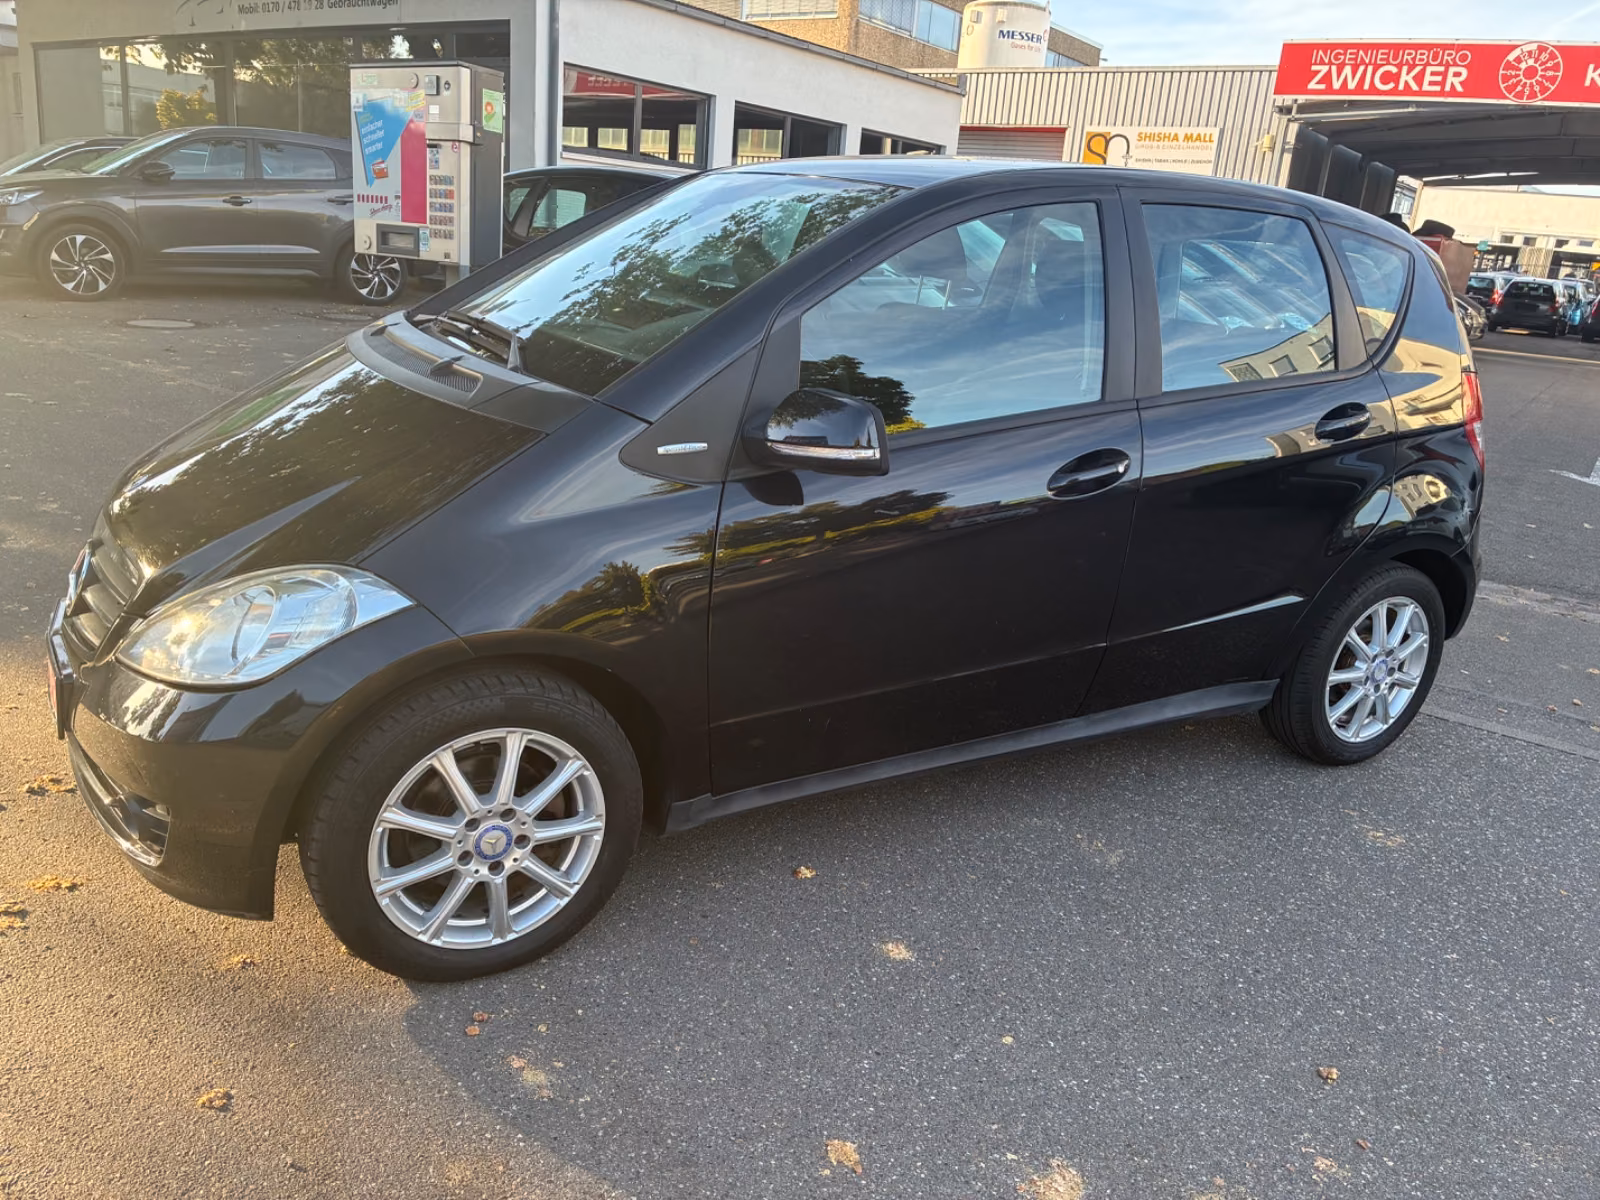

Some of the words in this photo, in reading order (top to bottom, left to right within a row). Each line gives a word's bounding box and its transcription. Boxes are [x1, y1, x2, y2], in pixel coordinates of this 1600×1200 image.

[261, 1, 279, 13] 0170
[314, 0, 324, 10] 28
[998, 29, 1042, 44] MESSER
[1311, 48, 1471, 66] INGENIEURBÜRO
[1307, 65, 1469, 92] ZWICKER
[1136, 131, 1179, 142] SHISHA
[1182, 132, 1215, 143] MALL
